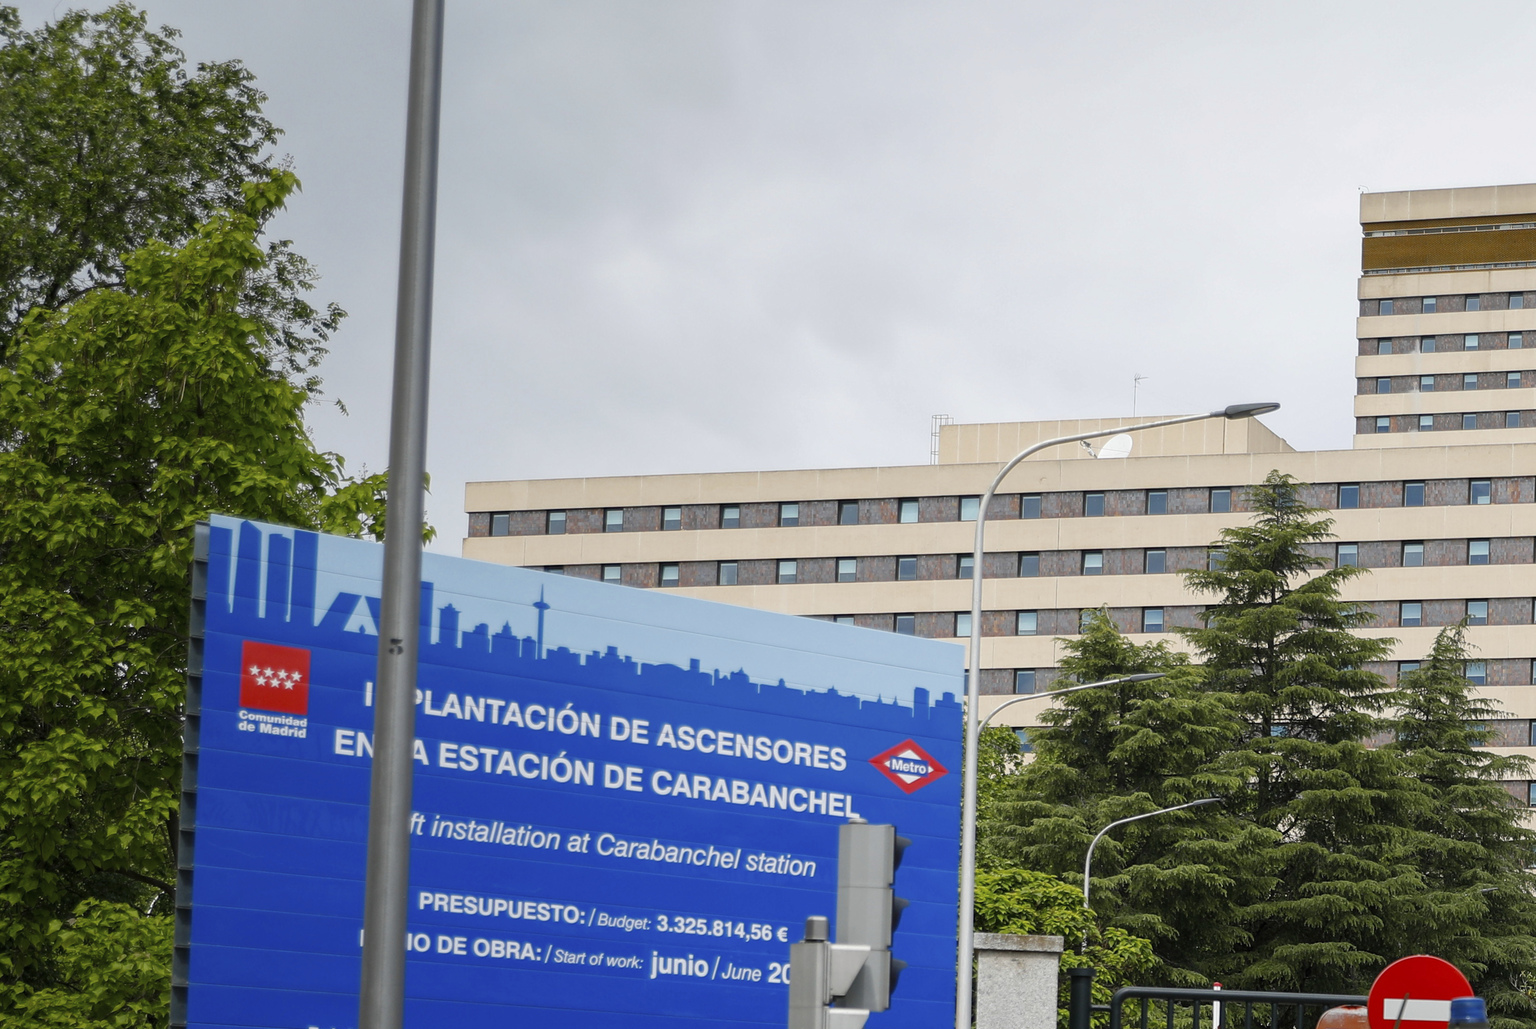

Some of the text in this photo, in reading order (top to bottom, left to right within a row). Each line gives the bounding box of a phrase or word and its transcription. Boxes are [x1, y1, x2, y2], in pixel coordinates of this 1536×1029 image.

[238, 720, 307, 739] de Madrid
[239, 710, 308, 728] Comunidad
[364, 681, 848, 772] ILANTACIÓN DE ASCENSORES
[334, 729, 861, 819] EN A ESTACIÓN DE CARABANCHEL
[891, 758, 927, 775] Metro
[409, 812, 816, 877] ft installation at Carabanchel station
[418, 892, 585, 924] PRESUPUESTO:
[597, 913, 652, 932] Budget:
[656, 915, 773, 942] 3.325.814,56
[777, 926, 789, 943] €
[360, 929, 431, 953] IIO
[437, 935, 468, 955] DE
[473, 938, 542, 961] OBRA:
[554, 949, 586, 965] Start
[589, 952, 604, 966] of
[606, 955, 644, 970] work:
[650, 951, 709, 979] junio
[722, 963, 762, 982] June
[768, 962, 791, 985] 20
